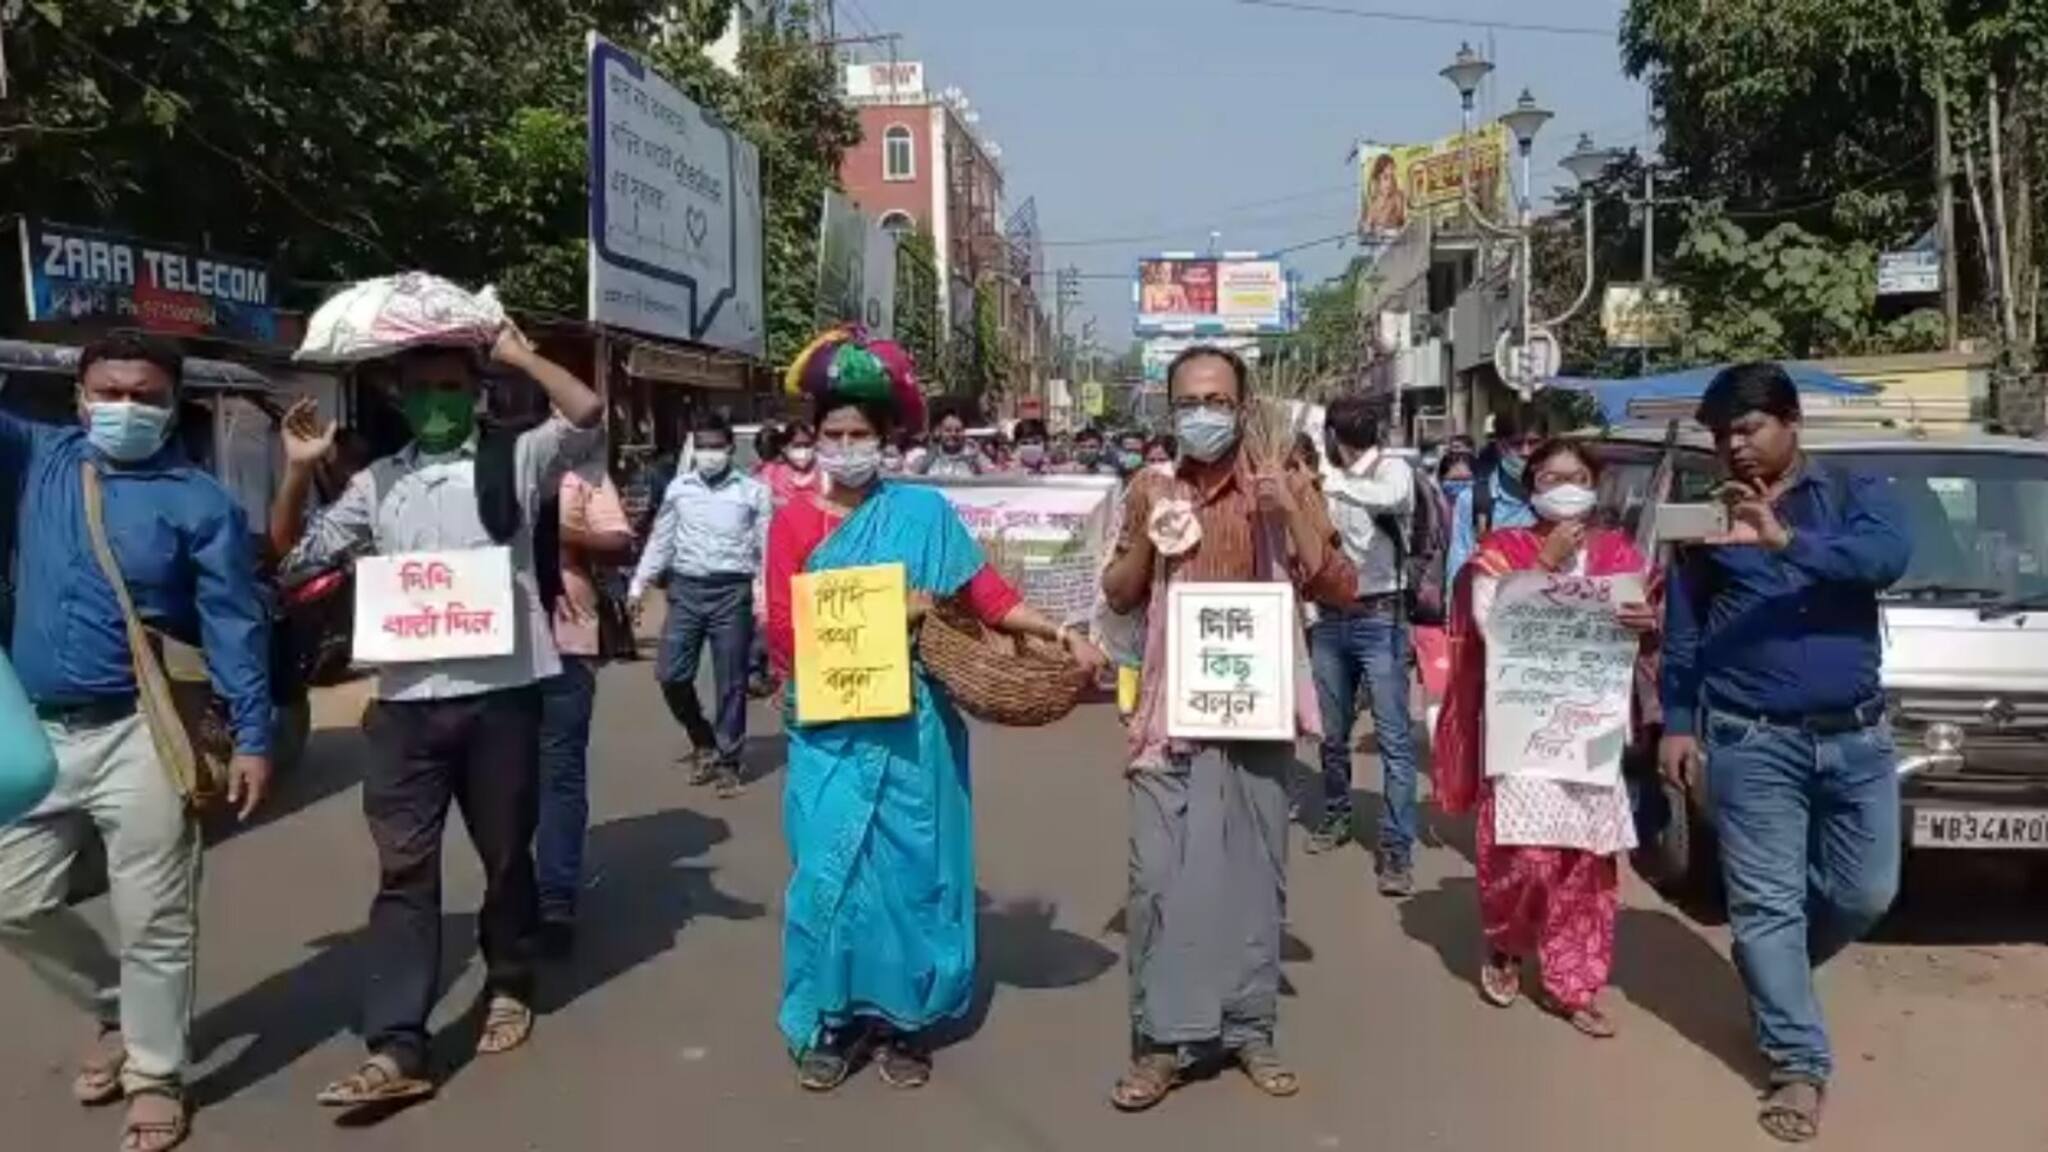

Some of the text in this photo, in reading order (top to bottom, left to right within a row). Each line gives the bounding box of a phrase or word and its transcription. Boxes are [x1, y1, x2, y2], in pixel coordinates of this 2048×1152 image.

[41, 233, 135, 286] ZARA
[143, 248, 268, 305] TELECOM
[1197, 604, 1256, 640] দিদি
[1197, 647, 1256, 684] কিছু
[1188, 688, 1262, 727] বলুন
[1930, 815, 2048, 842] WB34AR0
